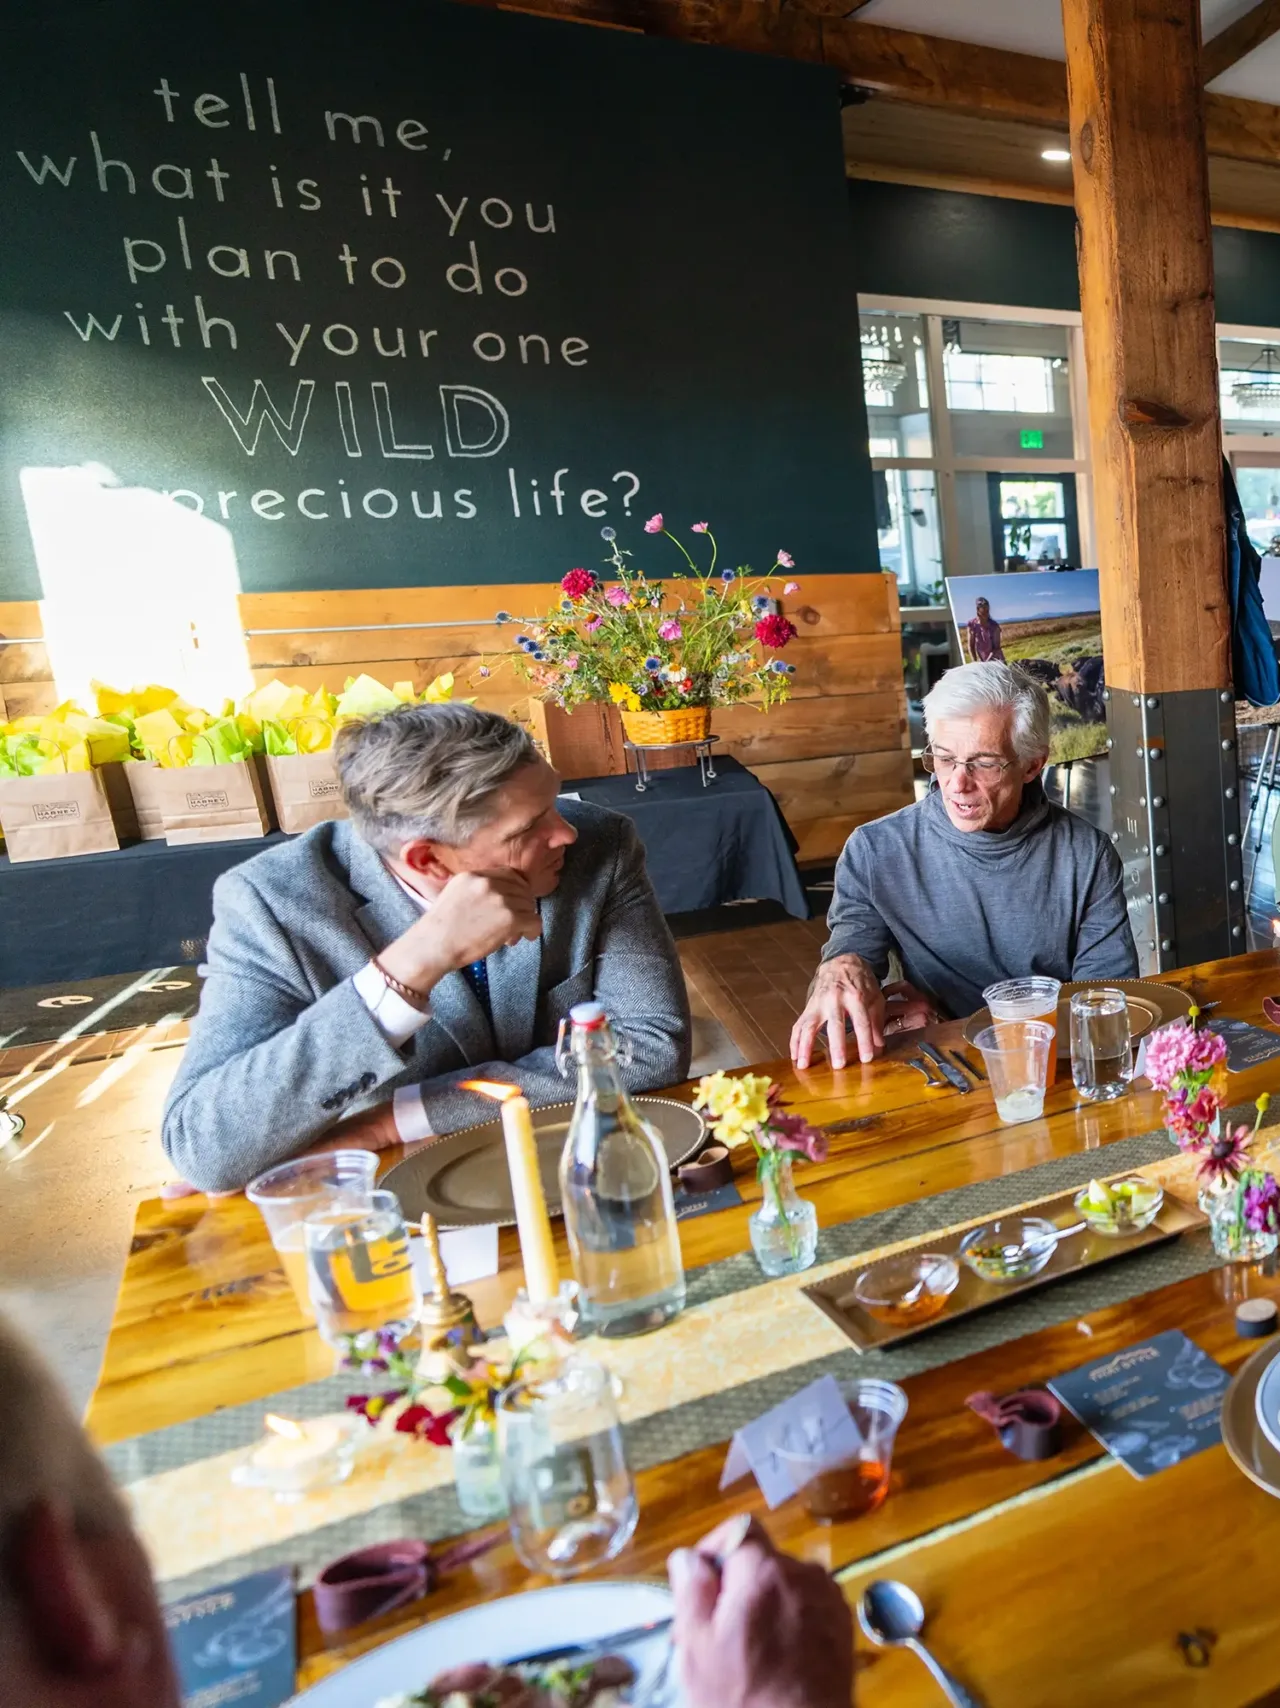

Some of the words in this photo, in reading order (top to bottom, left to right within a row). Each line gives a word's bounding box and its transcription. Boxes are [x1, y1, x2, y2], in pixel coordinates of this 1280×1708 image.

[153, 72, 281, 134] tell
[325, 109, 452, 161] me,
[16, 131, 230, 202] what
[270, 165, 321, 210] is
[360, 174, 401, 218] it
[436, 193, 556, 237] you
[123, 216, 301, 284] plan
[338, 244, 406, 288] to
[446, 240, 528, 296] do
[64, 295, 237, 350] with
[276, 322, 438, 366] your
[473, 332, 589, 366] one
[201, 376, 510, 460] WILD
[508, 467, 641, 518] life?
